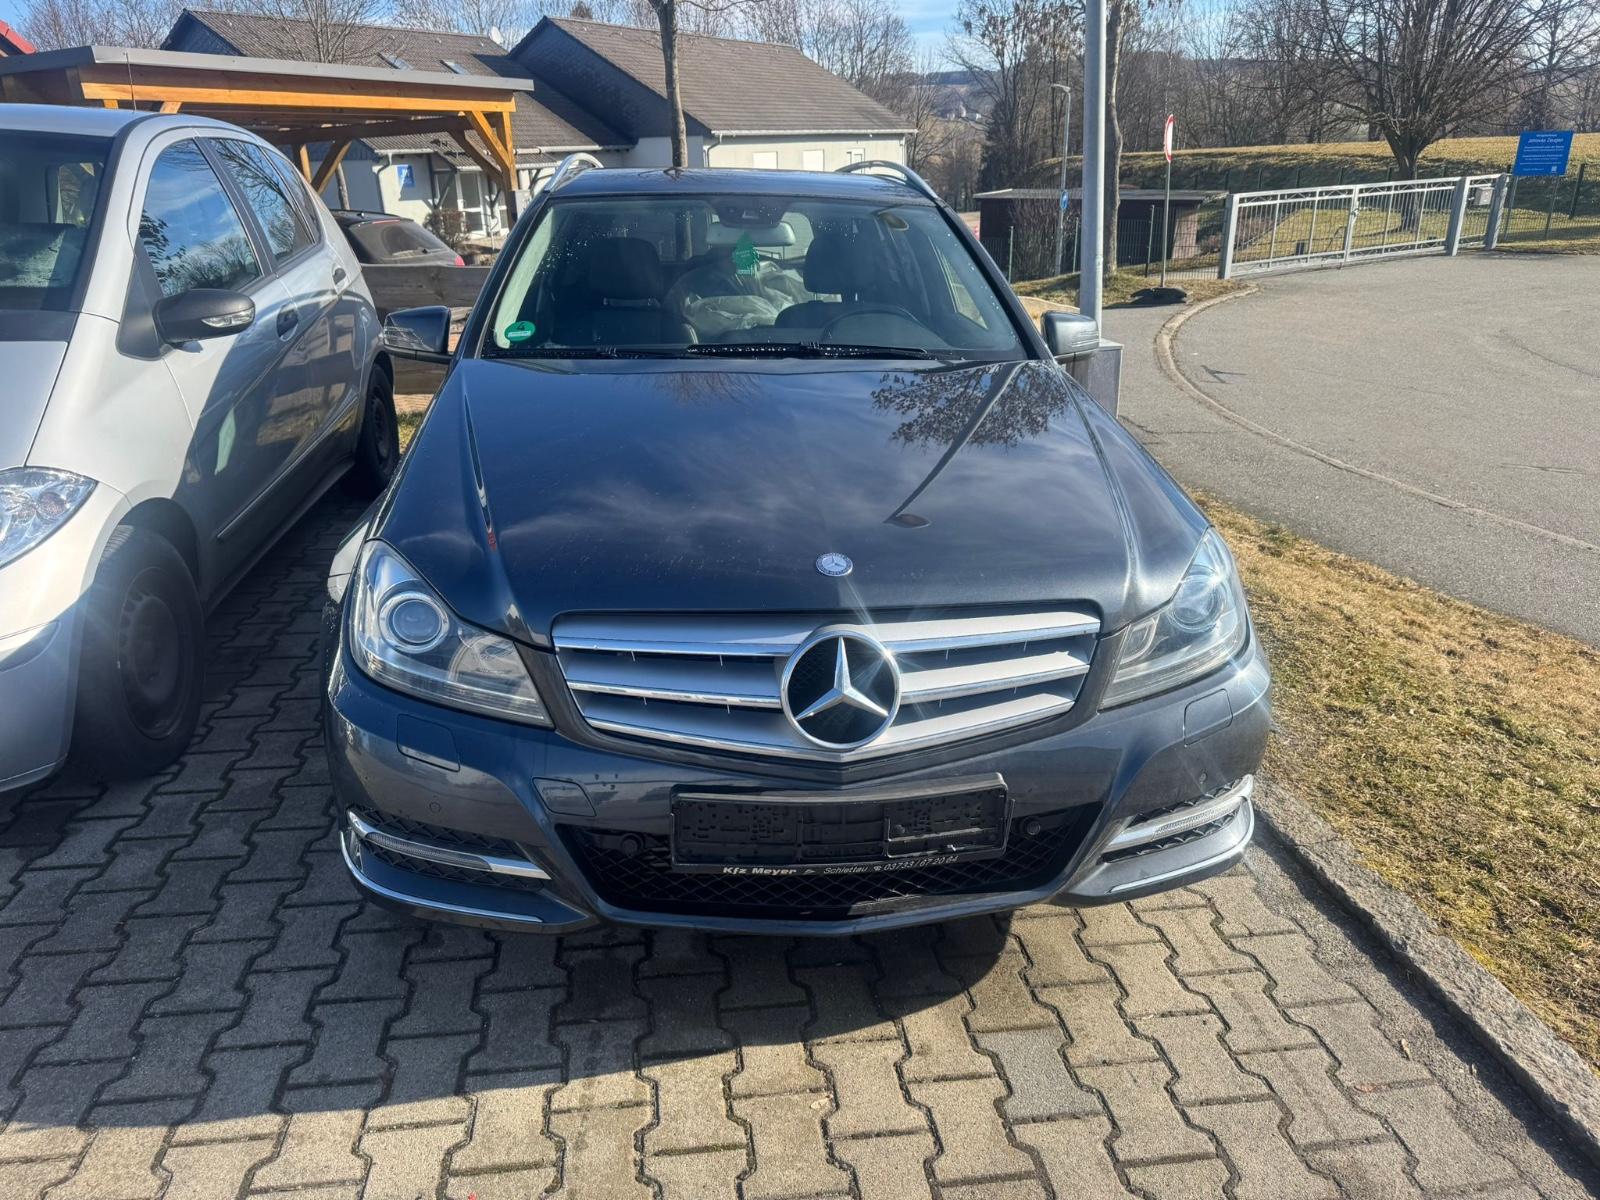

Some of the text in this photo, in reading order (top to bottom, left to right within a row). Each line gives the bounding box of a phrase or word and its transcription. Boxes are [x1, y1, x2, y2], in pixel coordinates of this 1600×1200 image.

[516, 322, 525, 330] 4
[723, 866, 748, 875] Kfz
[751, 867, 797, 876] Meyer
